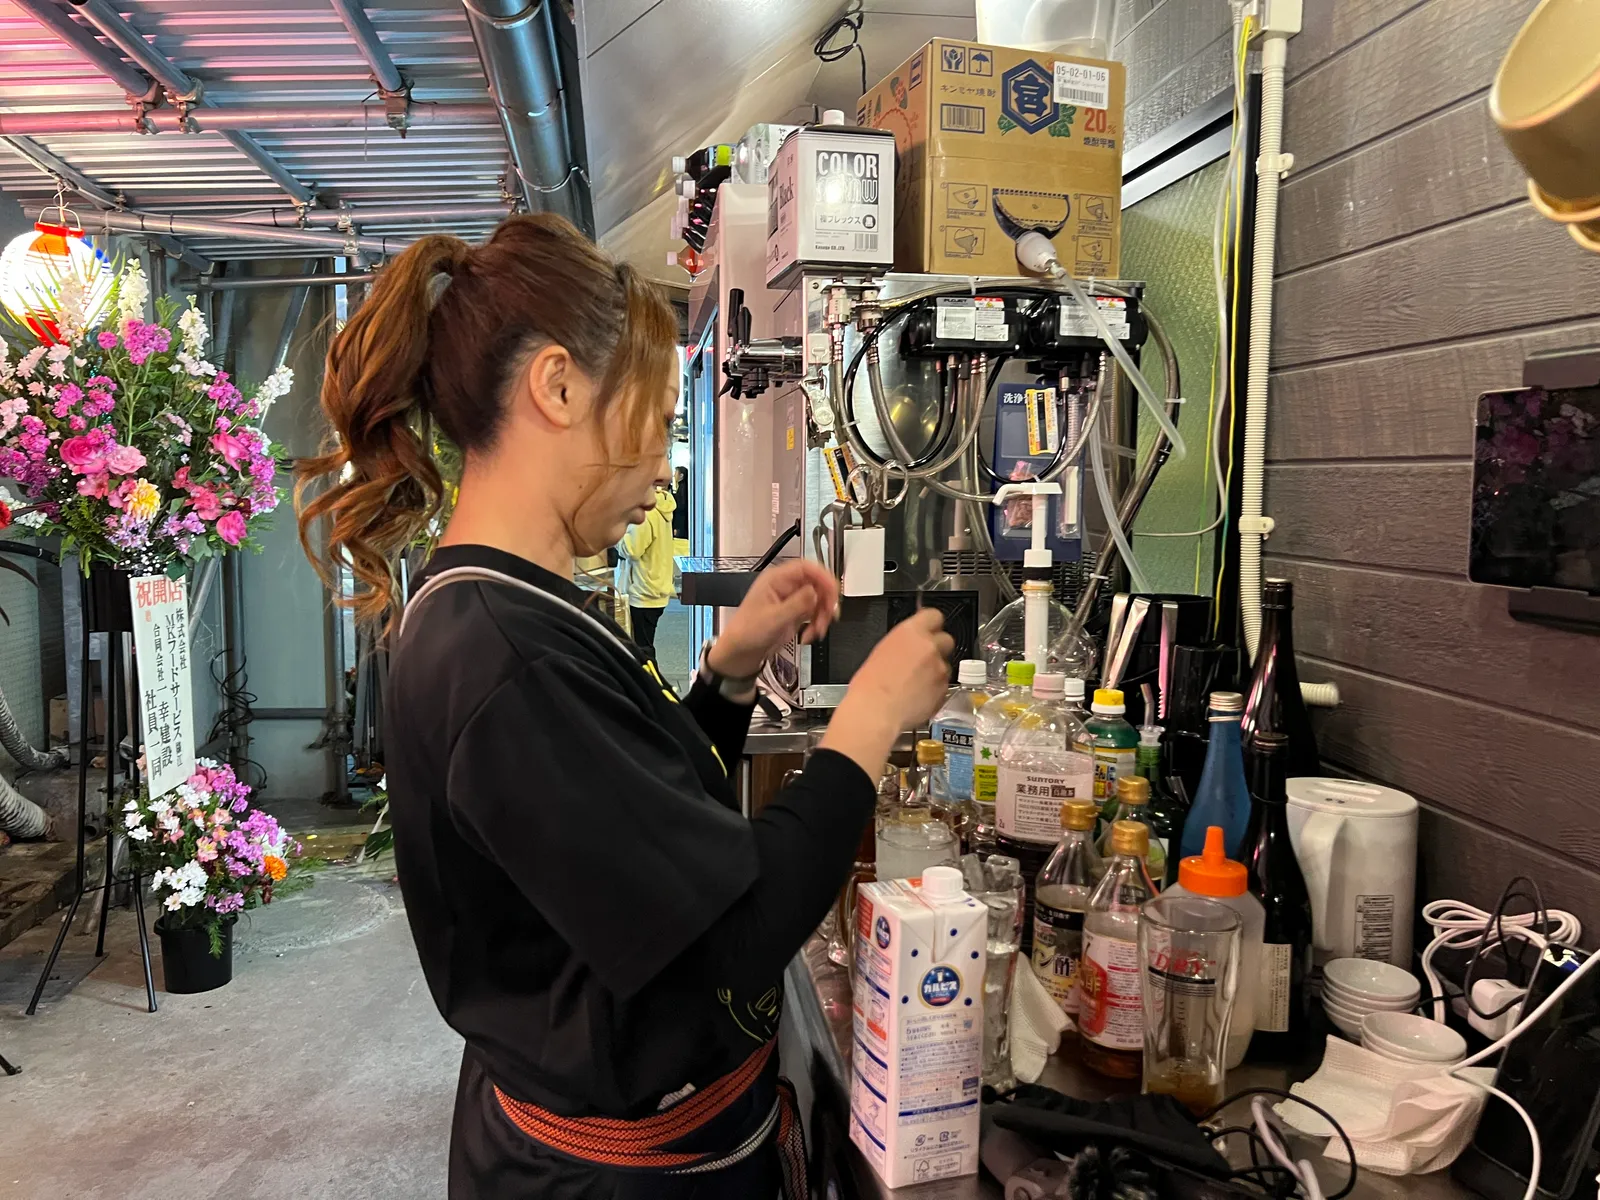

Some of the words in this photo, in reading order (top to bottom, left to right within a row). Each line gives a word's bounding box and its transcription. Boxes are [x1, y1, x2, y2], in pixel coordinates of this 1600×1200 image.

[1056, 65, 1106, 82] 05-02-01-06
[940, 83, 997, 99] キンミヤ焼酎
[818, 152, 879, 179] COLOR
[1003, 392, 1027, 404] 洗浄
[135, 578, 184, 608] 祝開店
[175, 607, 188, 671] 株式会社
[144, 688, 162, 781] 社員一同
[1026, 775, 1066, 785] SUNTORY
[1016, 783, 1050, 797] 業務用
[924, 980, 957, 994] カルピス
